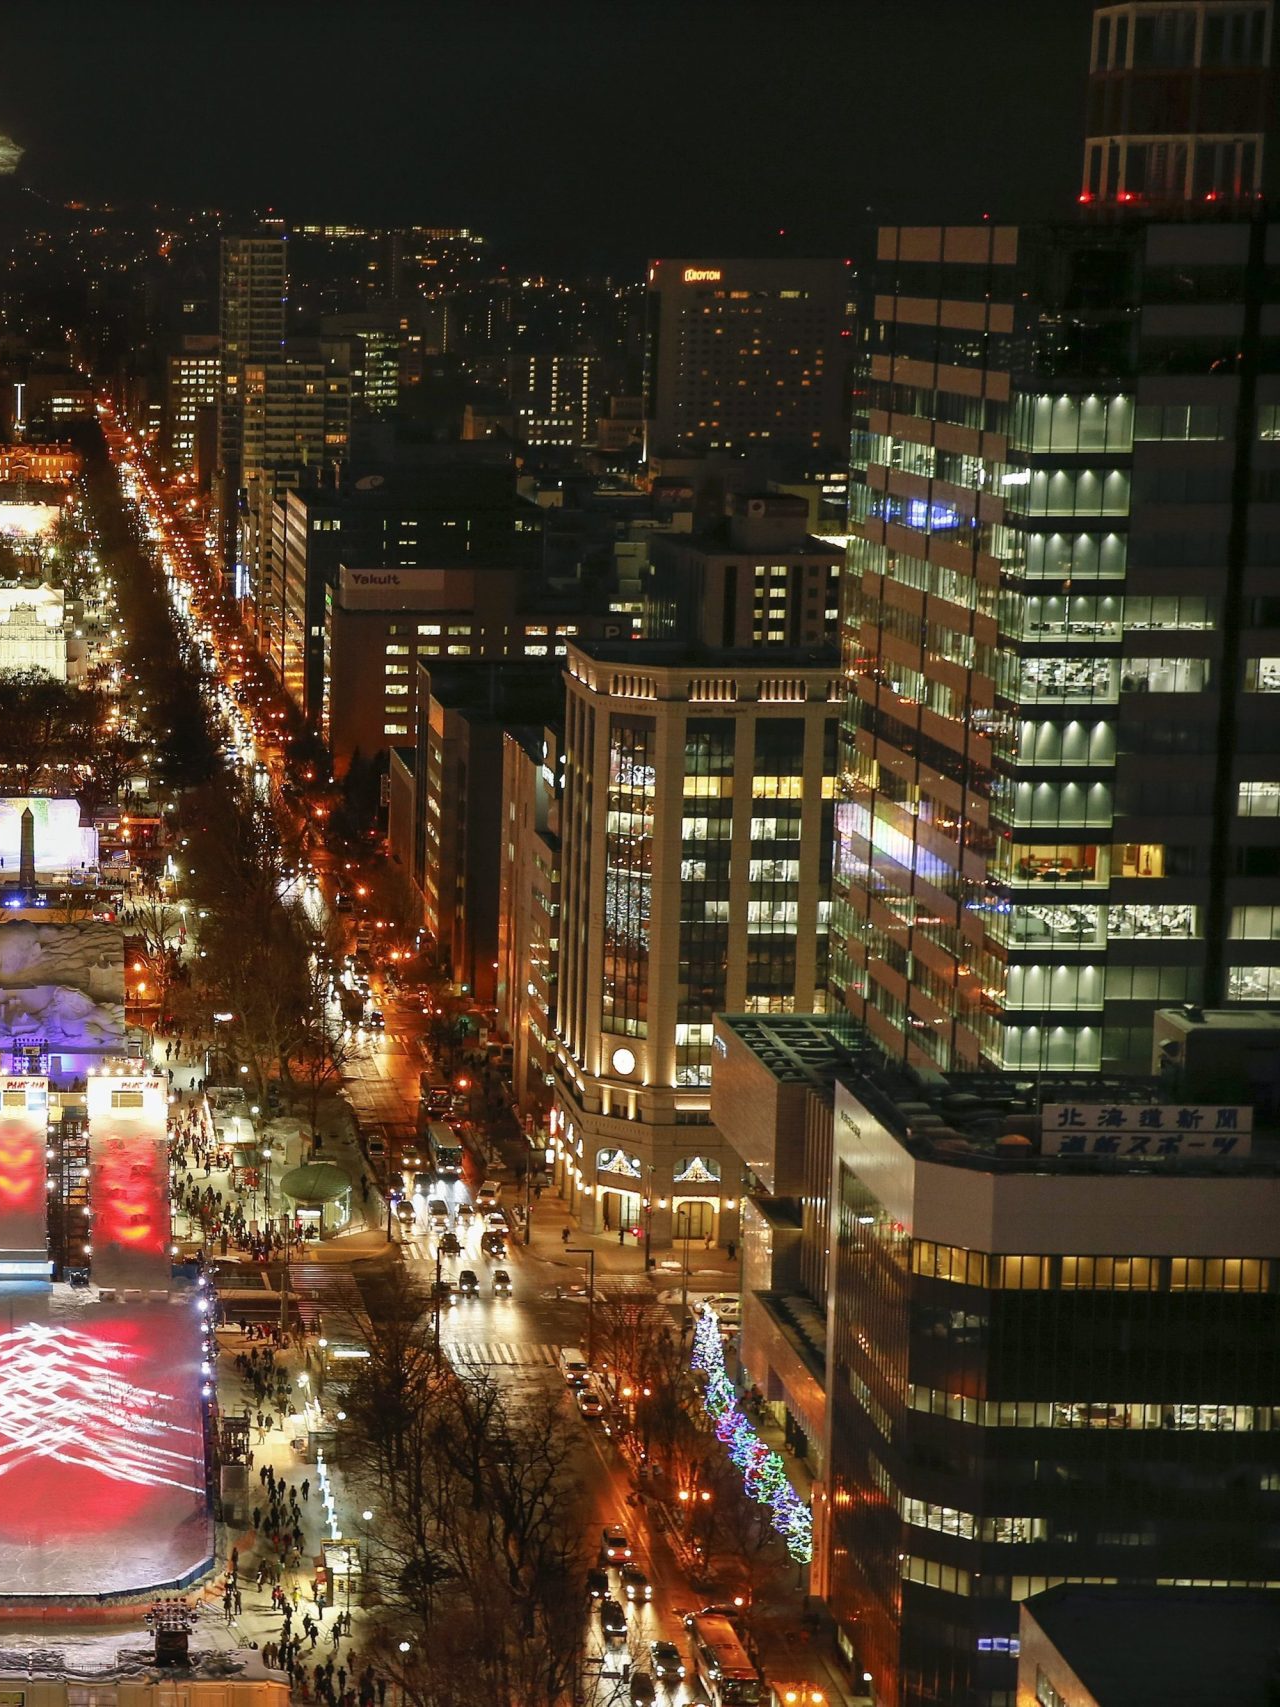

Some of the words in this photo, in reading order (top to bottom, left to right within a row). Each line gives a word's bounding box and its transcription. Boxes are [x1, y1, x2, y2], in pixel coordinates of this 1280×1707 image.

[352, 573, 401, 585] Yakult
[605, 625, 621, 639] P
[1058, 1107, 1240, 1129] 北海道新聞
[1058, 1134, 1239, 1154] 道新スポーツ
